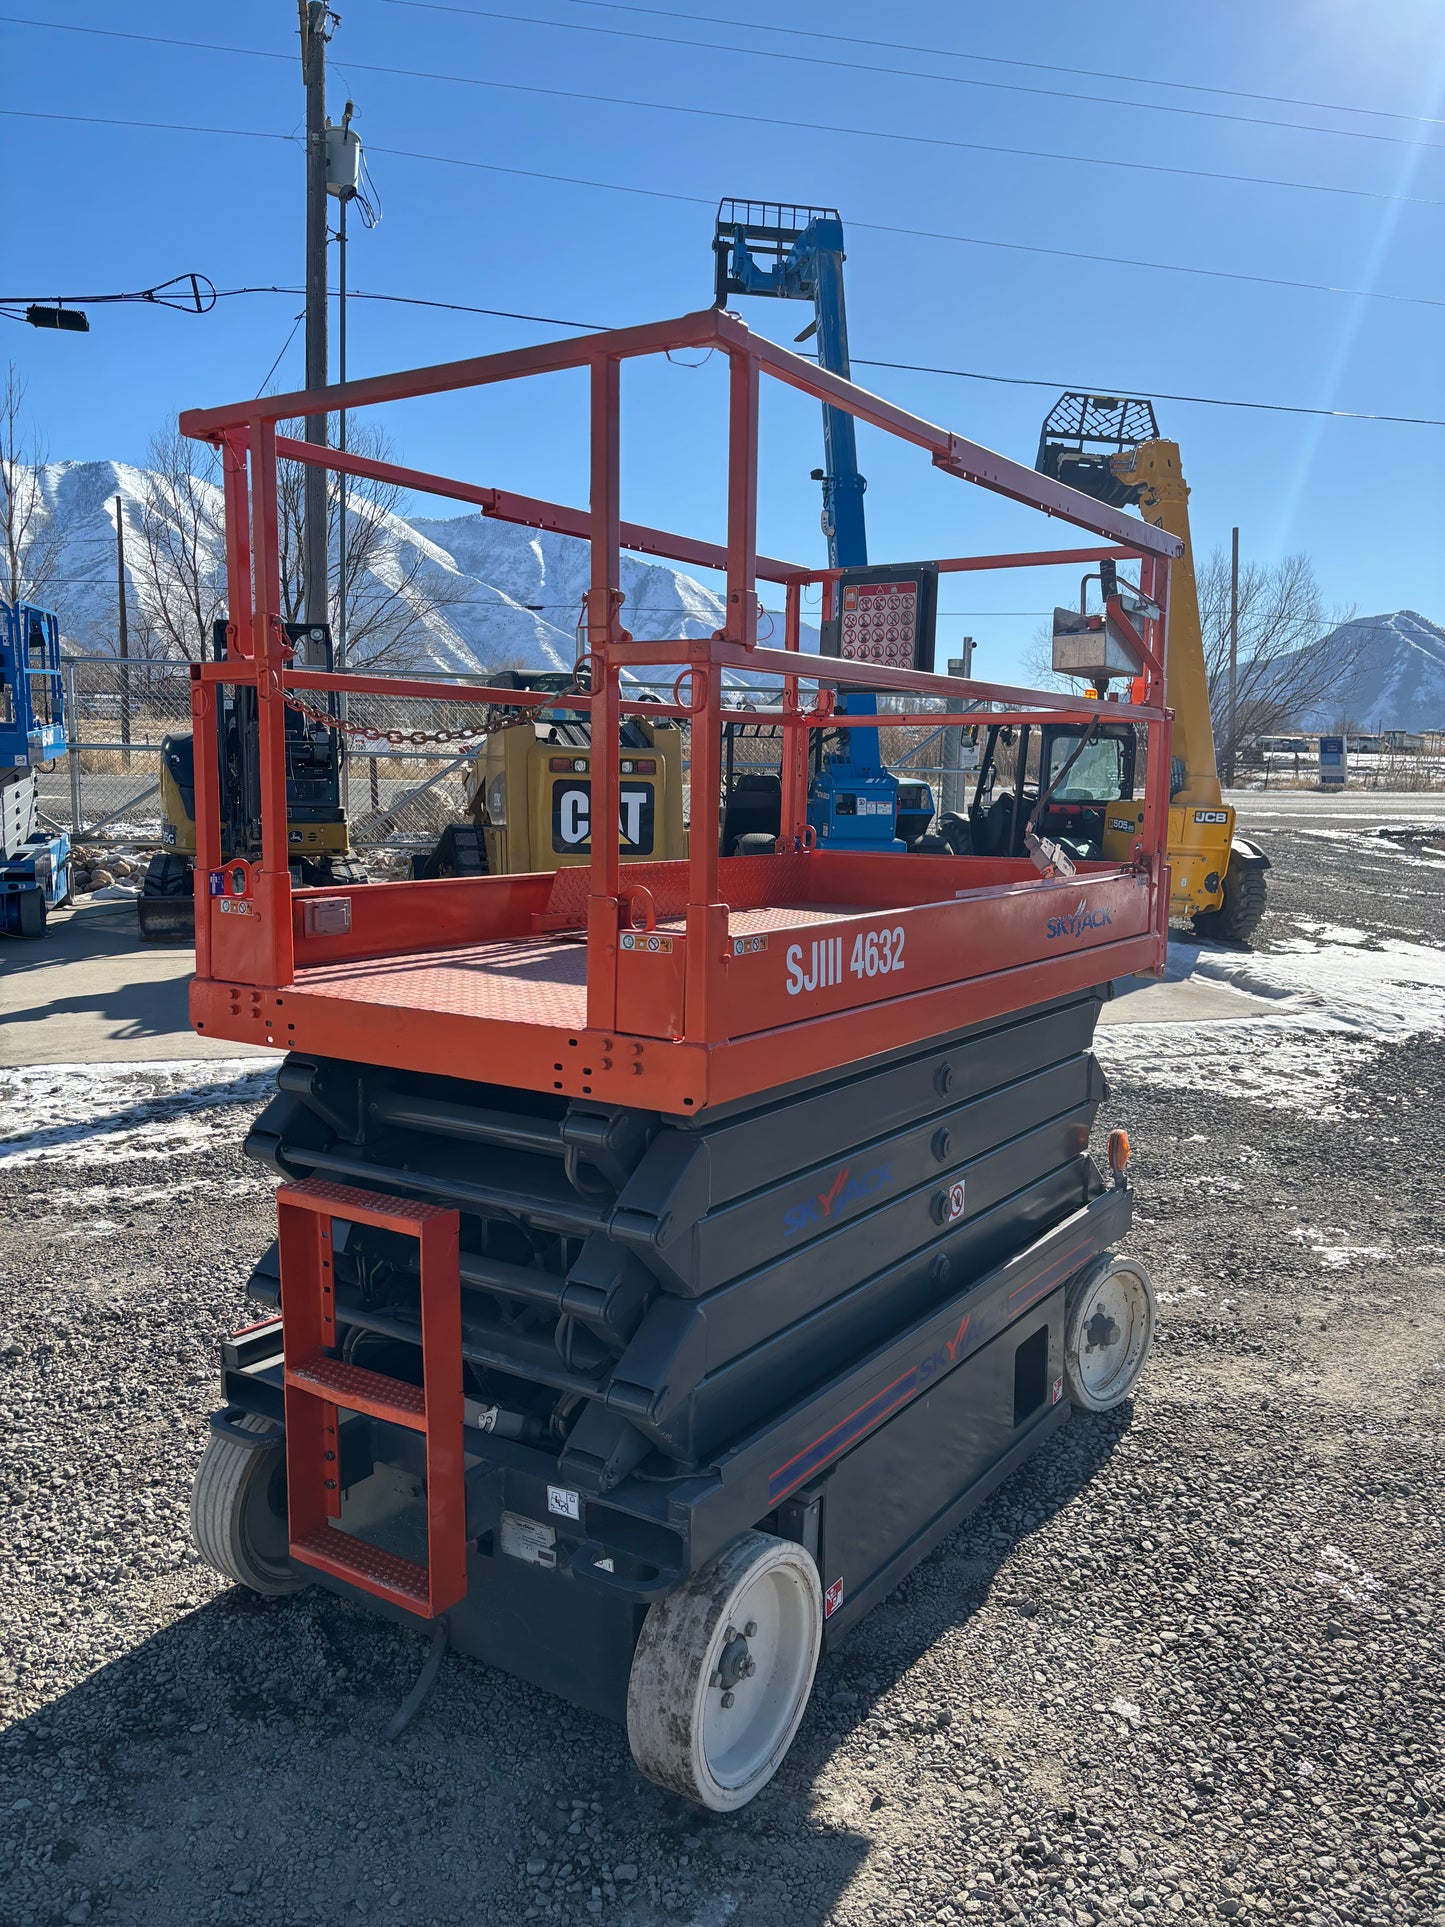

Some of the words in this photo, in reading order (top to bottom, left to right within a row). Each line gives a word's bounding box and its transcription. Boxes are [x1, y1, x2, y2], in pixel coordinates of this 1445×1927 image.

[561, 791, 647, 845] CT
[1195, 812, 1227, 823] JCB
[1046, 899, 1112, 939] SKYJACK
[786, 936, 842, 995] SJIII
[850, 926, 905, 979] 4632
[783, 1163, 894, 1236] SKYJACK
[920, 1304, 1004, 1383] SKYJA
